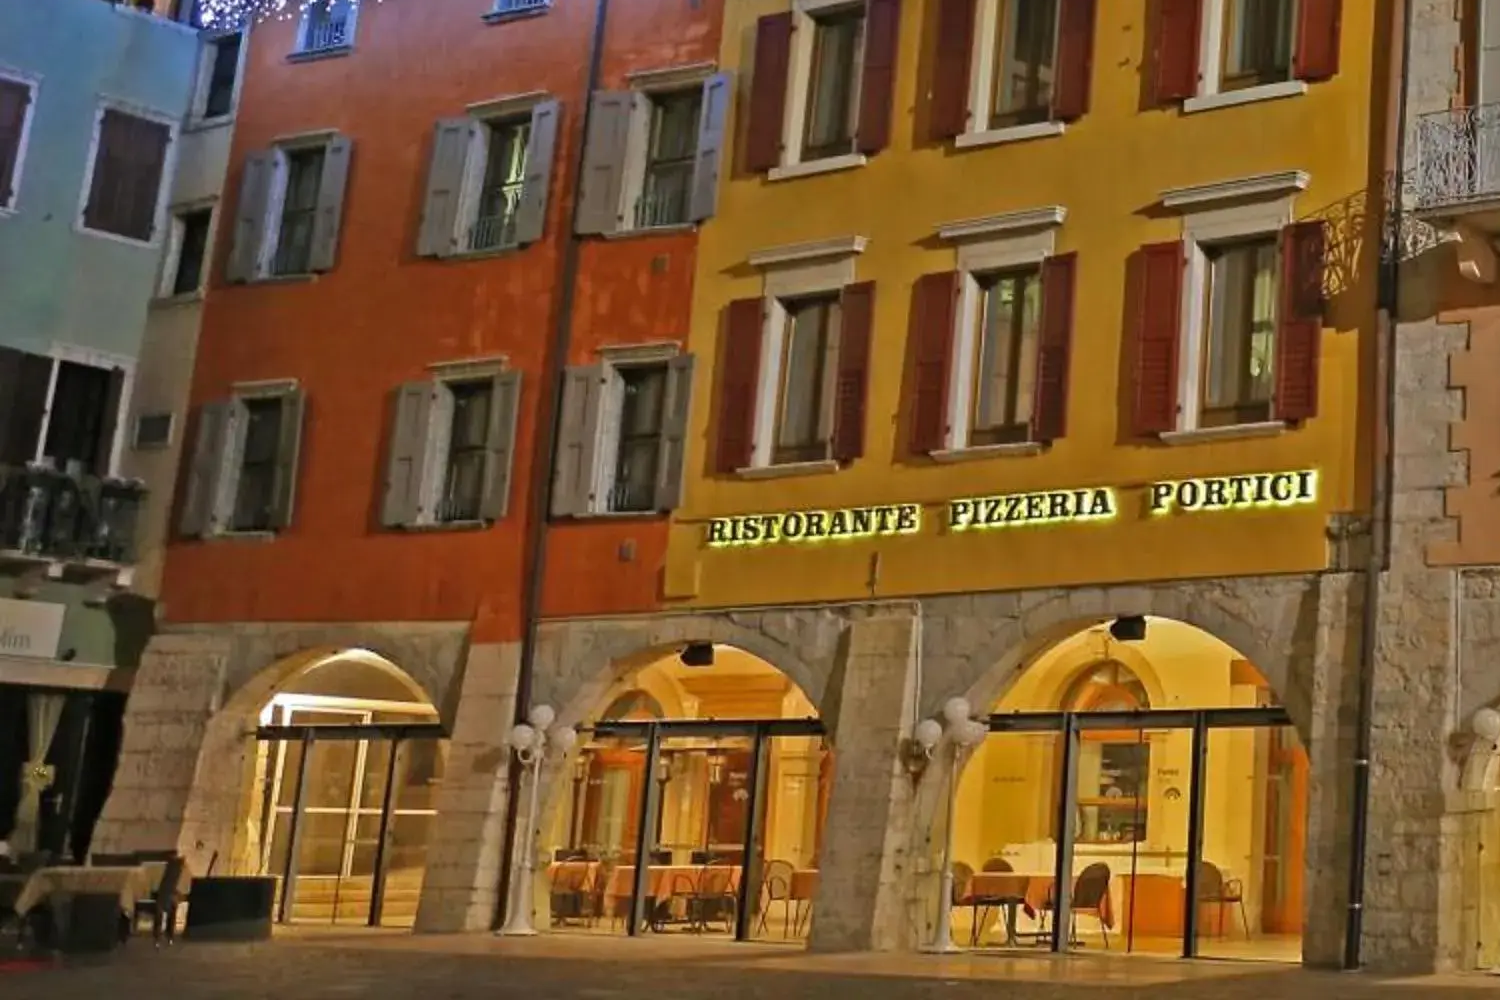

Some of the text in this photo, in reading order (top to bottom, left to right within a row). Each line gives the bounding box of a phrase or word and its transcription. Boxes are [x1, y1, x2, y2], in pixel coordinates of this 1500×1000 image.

[706, 470, 1314, 544] RISTORANTE PIZZERIA PORTICI
